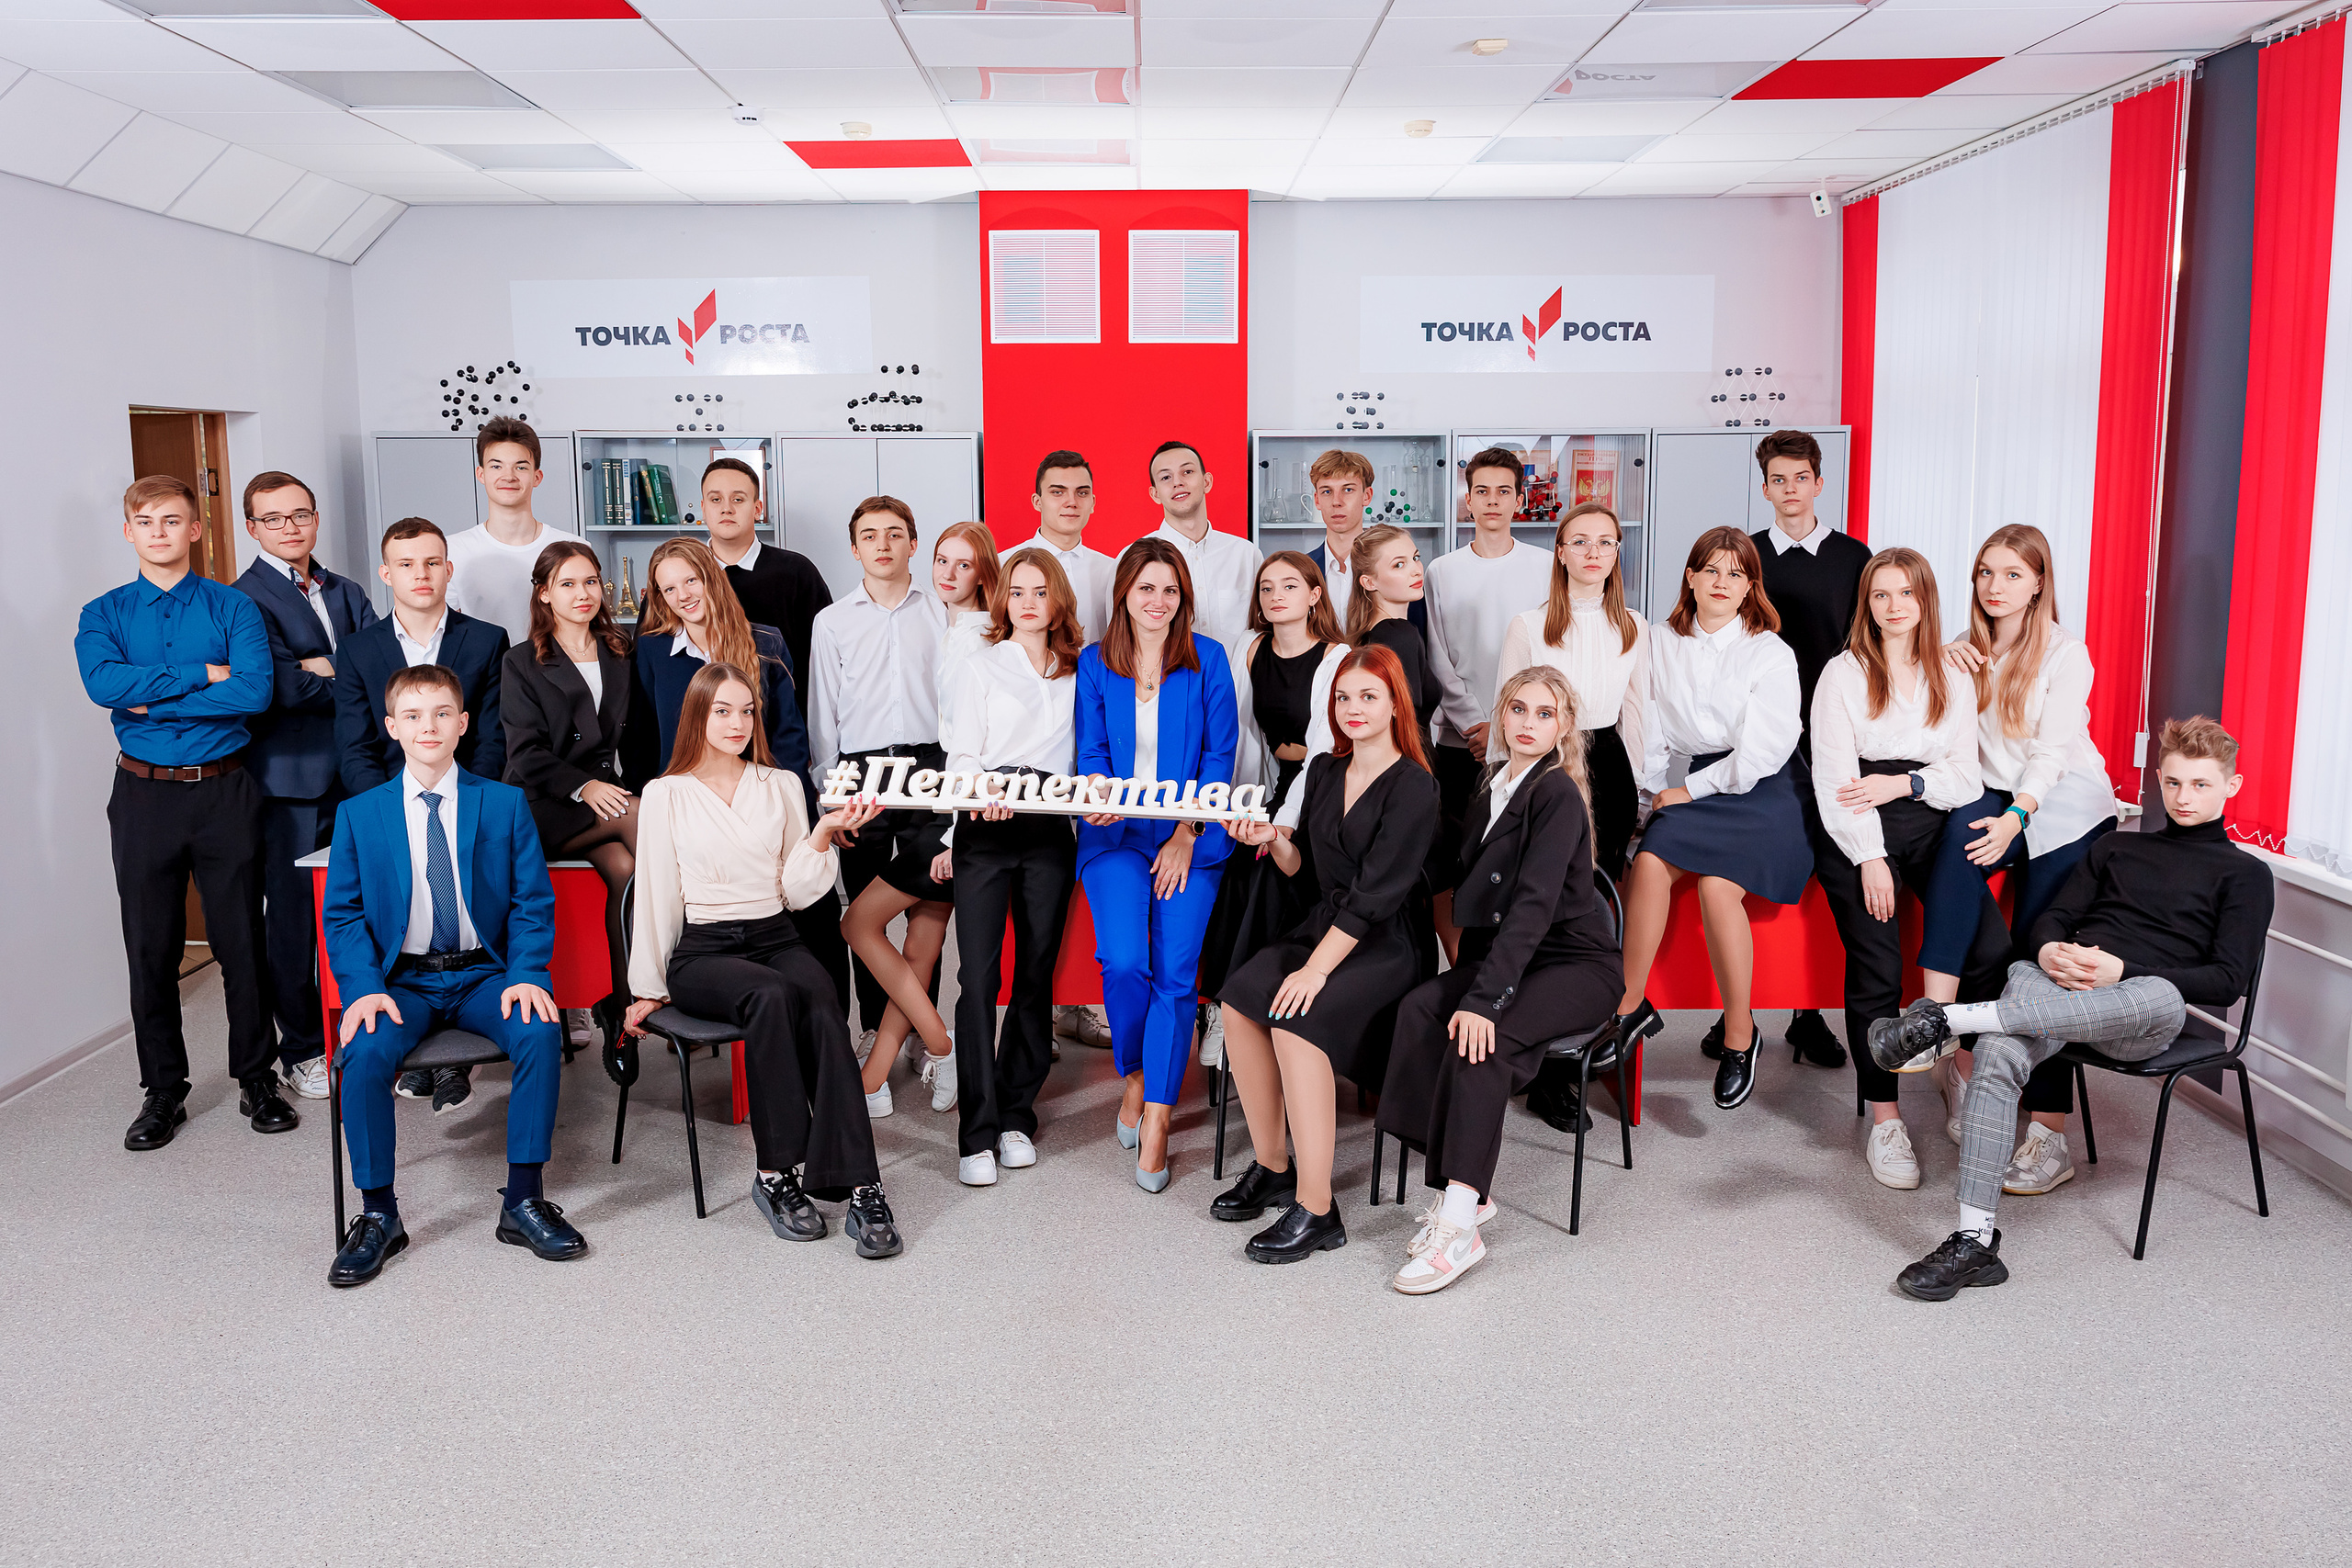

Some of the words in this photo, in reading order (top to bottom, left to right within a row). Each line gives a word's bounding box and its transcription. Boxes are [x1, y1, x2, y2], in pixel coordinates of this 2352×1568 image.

[575, 325, 672, 346] ТОЧКА
[719, 323, 810, 344] РОСТА
[1421, 321, 1514, 342] ТОЧКА
[1563, 321, 1652, 341] РОСТА
[658, 495, 663, 503] 2
[822, 755, 1268, 813] #Перспектива
